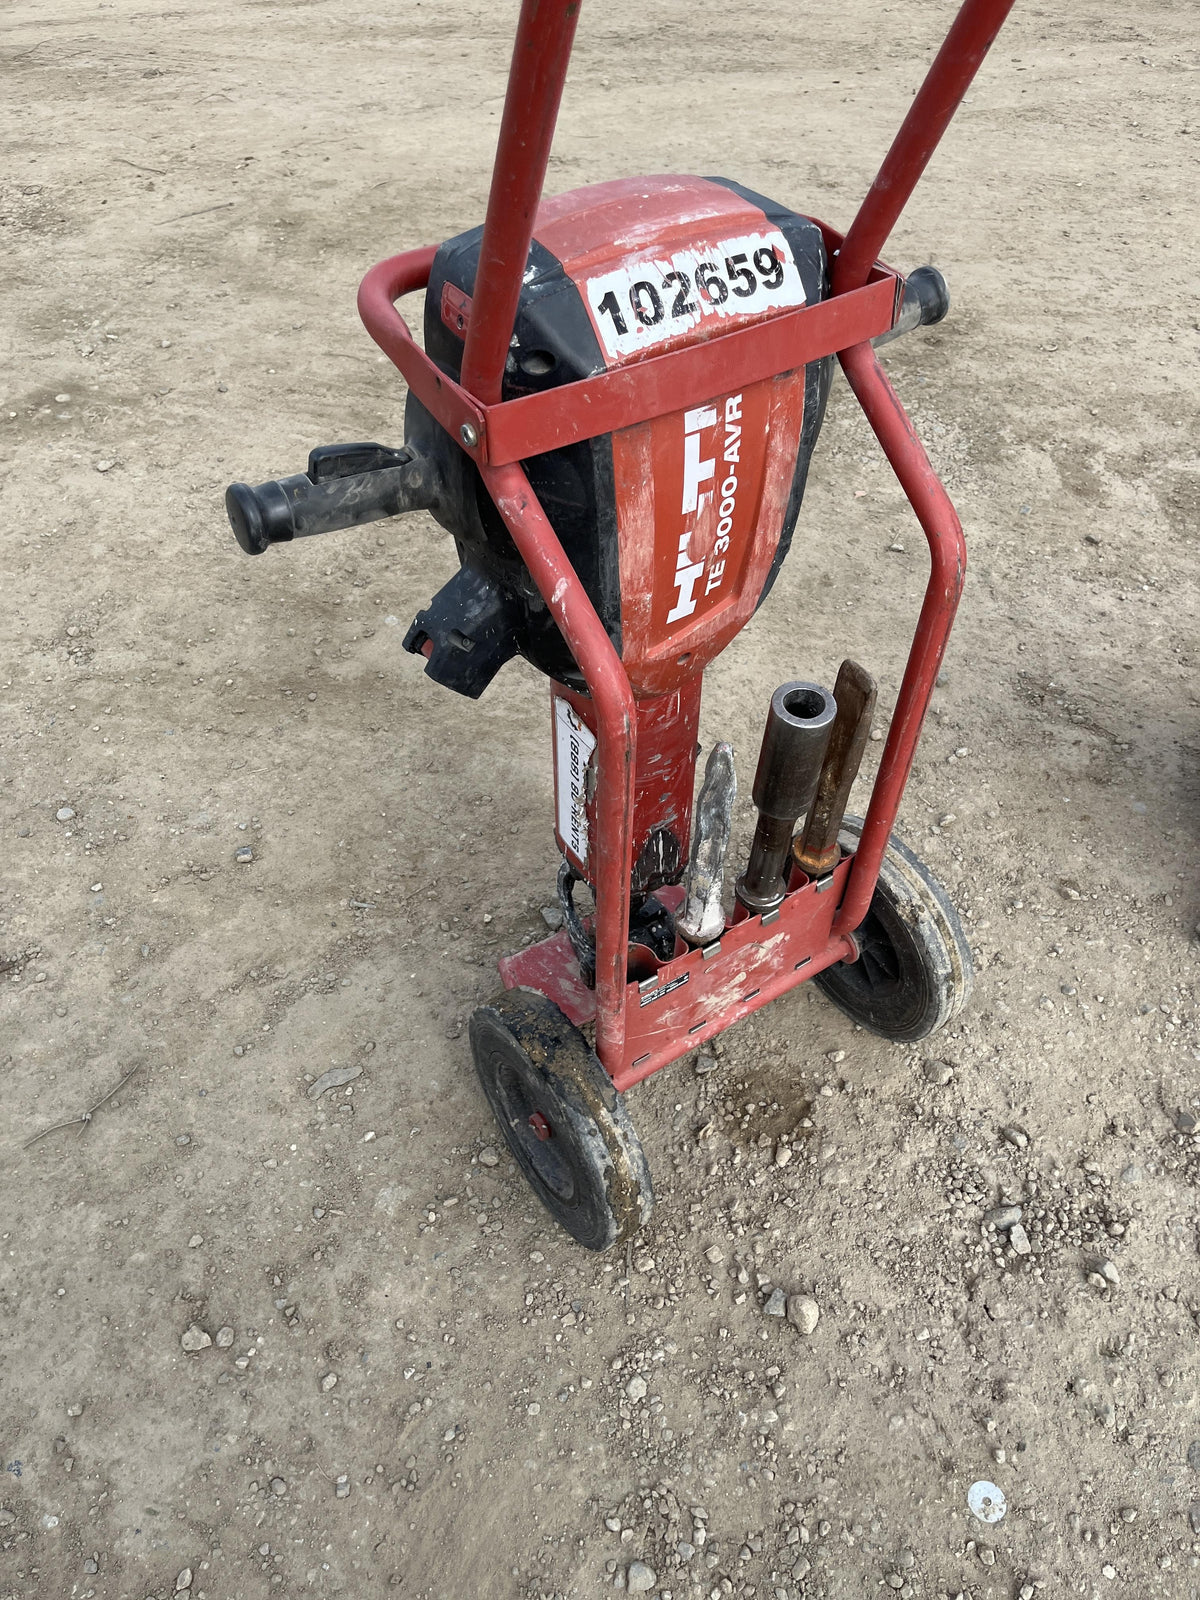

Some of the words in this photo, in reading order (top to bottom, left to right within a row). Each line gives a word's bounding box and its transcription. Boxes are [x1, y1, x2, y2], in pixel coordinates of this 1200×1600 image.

[597, 247, 785, 336] 102659
[713, 393, 743, 556] 3000-AVR
[704, 559, 727, 596] TE
